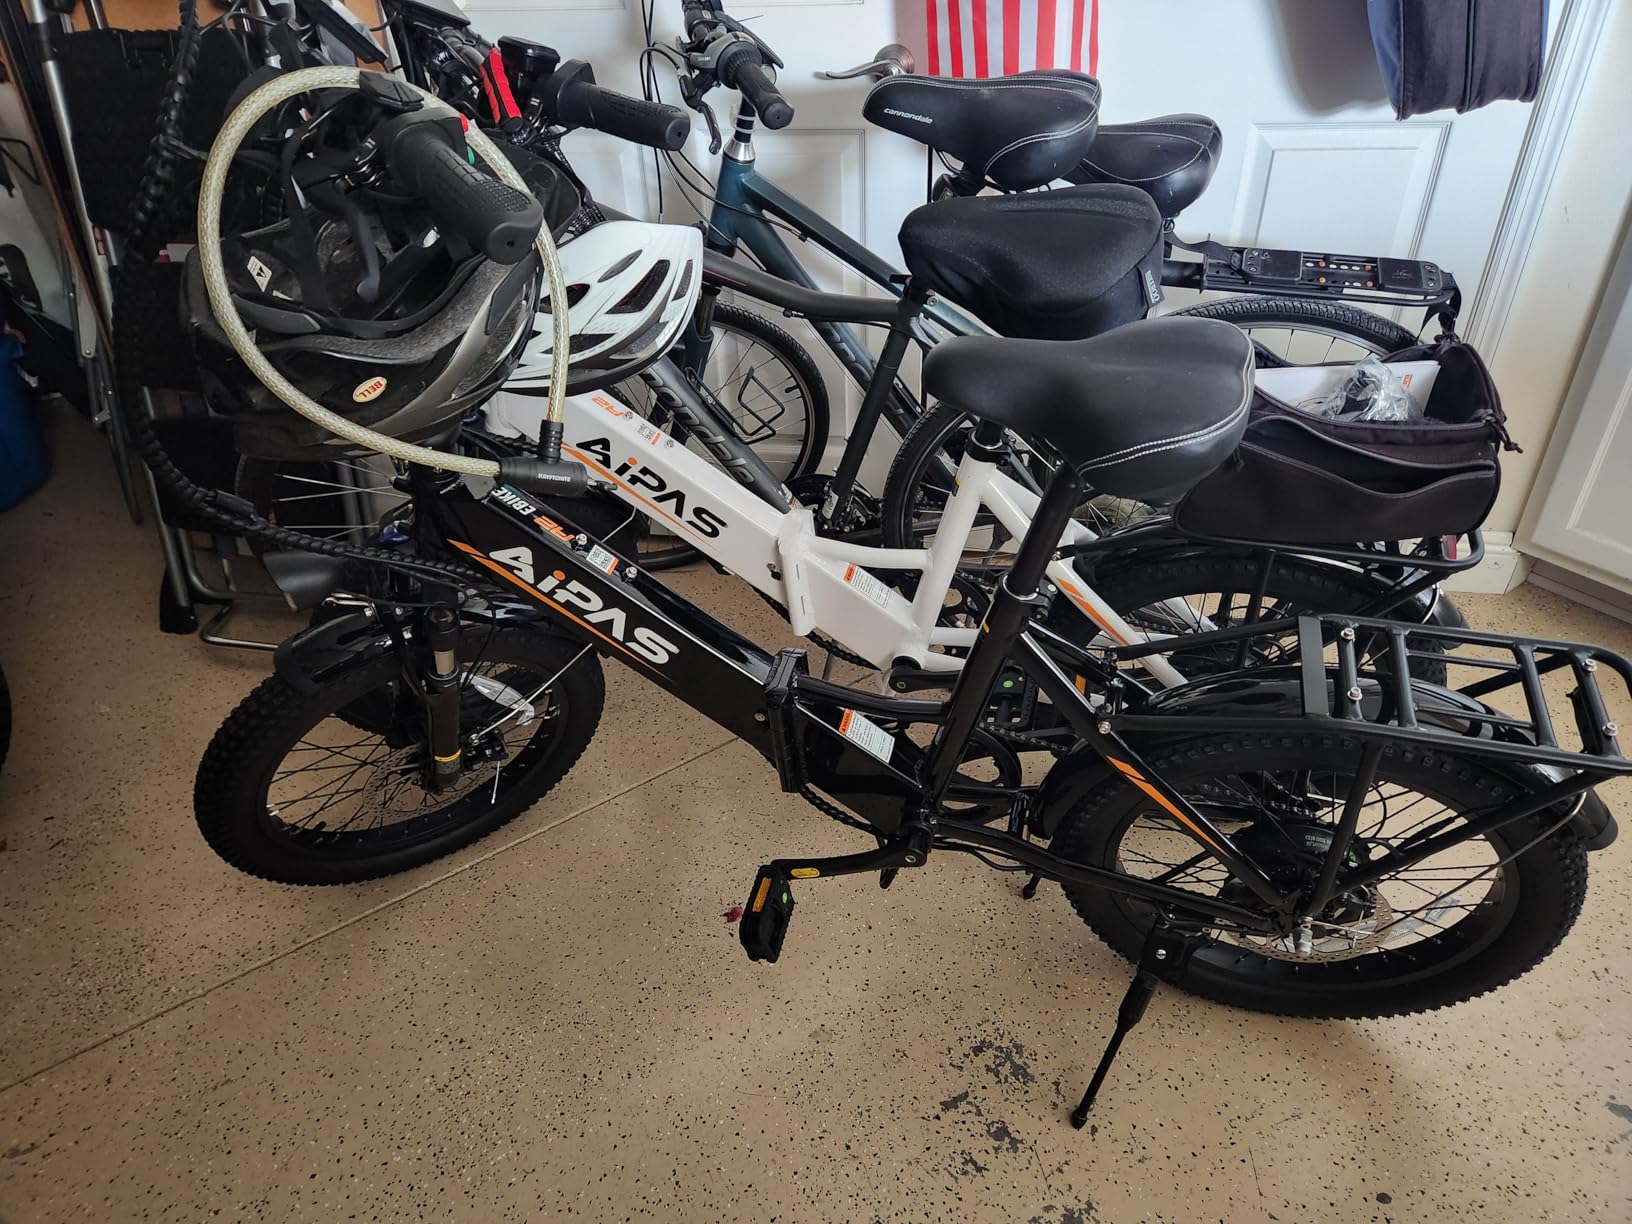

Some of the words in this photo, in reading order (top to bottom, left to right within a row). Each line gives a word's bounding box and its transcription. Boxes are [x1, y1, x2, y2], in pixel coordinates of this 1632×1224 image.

[884, 108, 933, 124] cannondale
[359, 381, 383, 398] BELL
[641, 366, 755, 483] nondale
[491, 486, 536, 516] EBIKE
